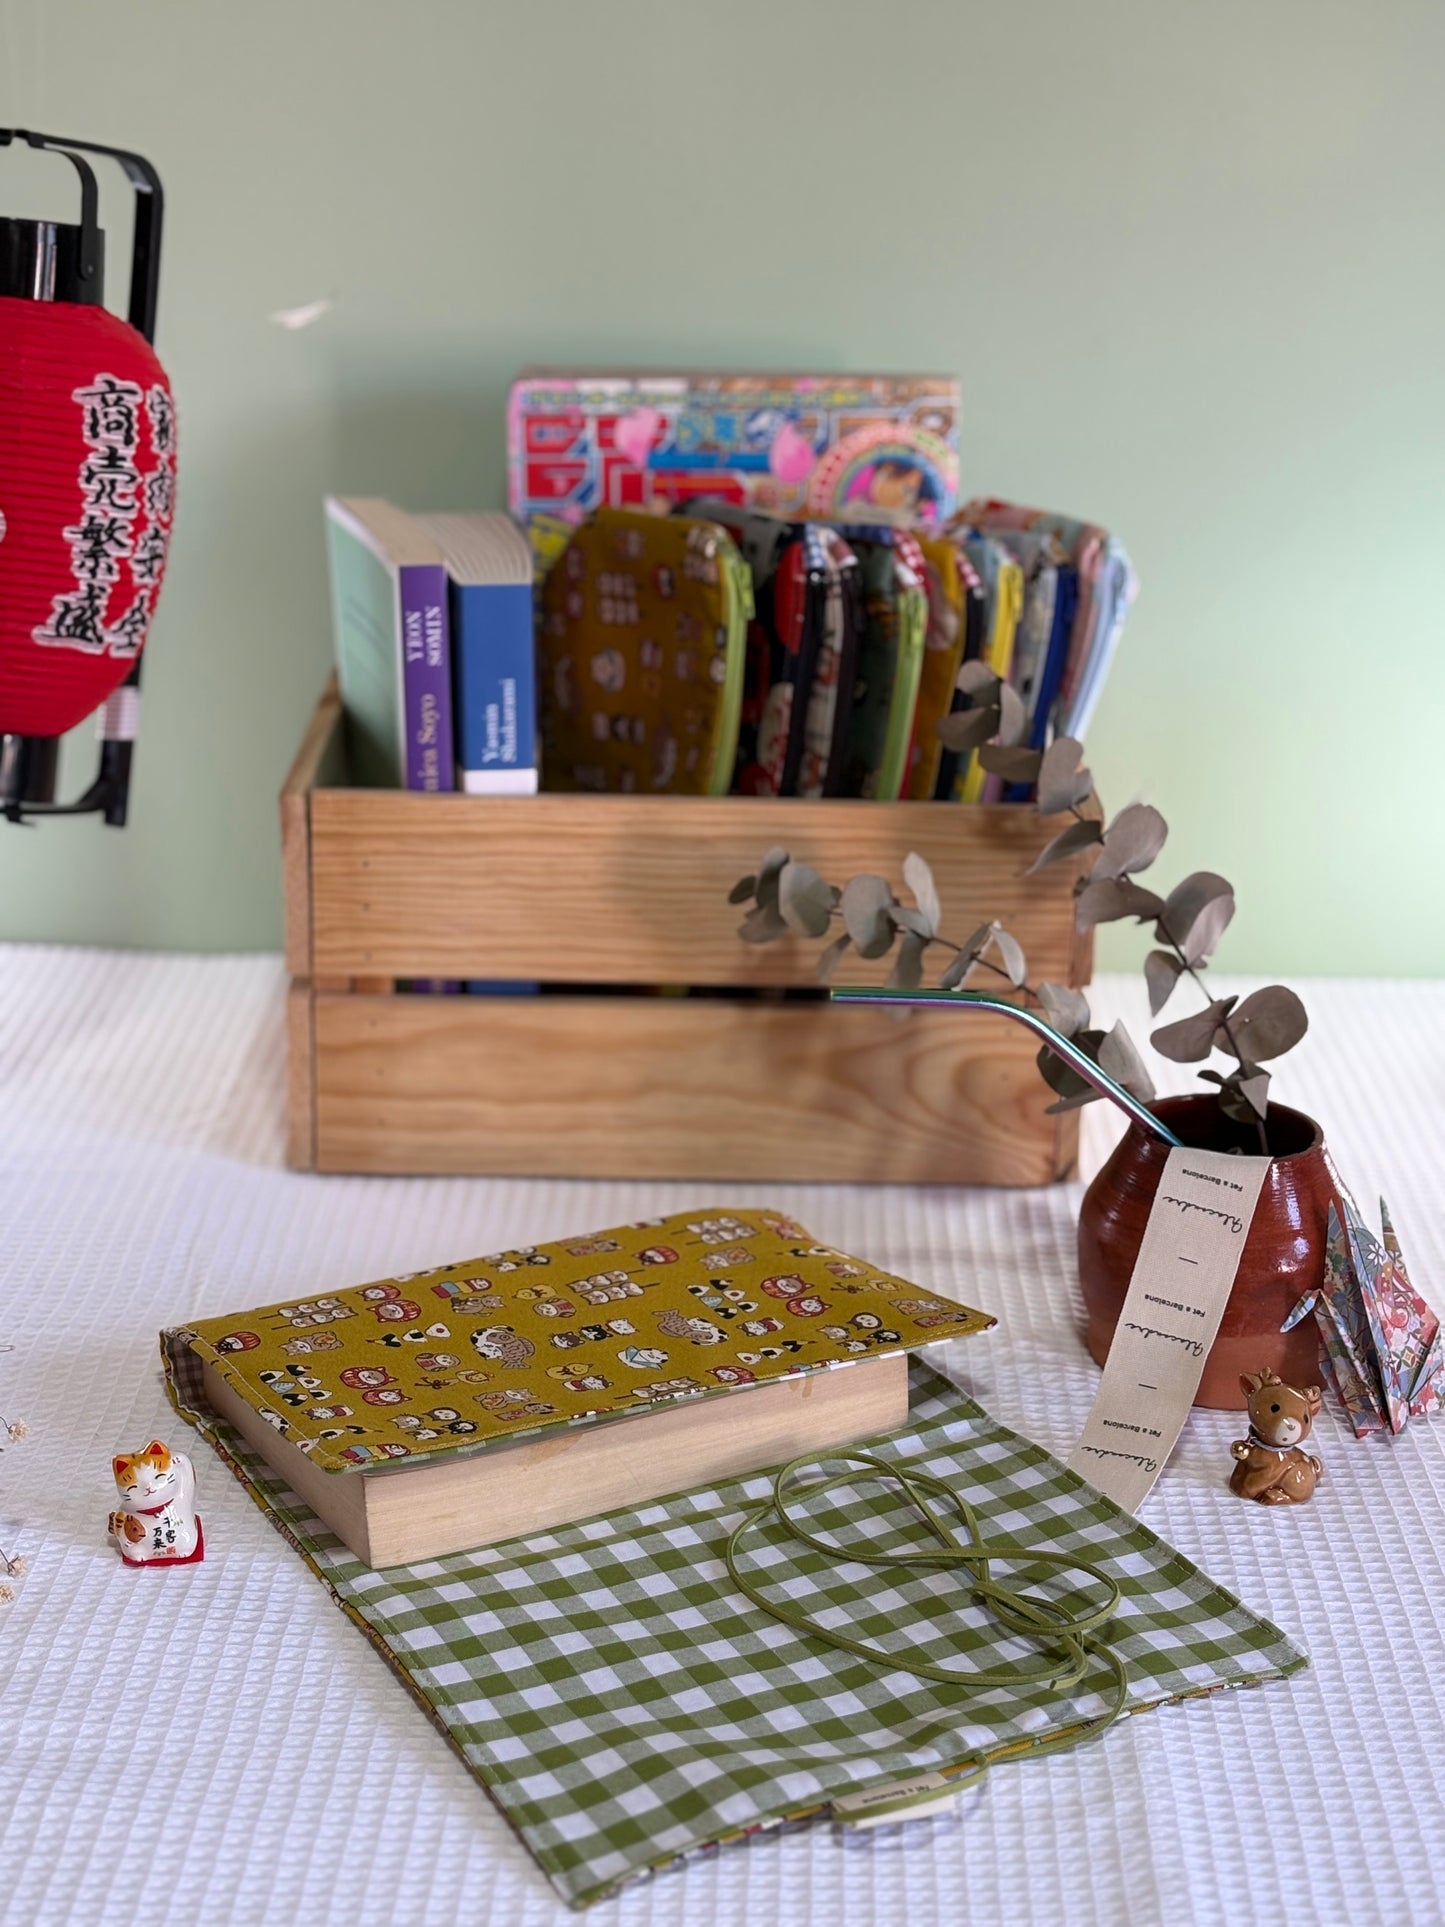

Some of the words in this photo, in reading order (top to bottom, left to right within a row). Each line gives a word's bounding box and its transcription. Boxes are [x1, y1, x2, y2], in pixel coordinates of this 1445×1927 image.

[406, 610, 423, 662] YEON
[424, 605, 443, 668] SOMIN
[416, 693, 440, 744] Soyo
[1181, 1168, 1222, 1187] Barcelona
[1229, 1182, 1244, 1193] Fet
[1144, 1293, 1184, 1312] Barcelona
[1191, 1307, 1206, 1318] Fet
[1102, 1419, 1140, 1434] Barcelona
[1148, 1428, 1162, 1438] Fet
[152, 1526, 167, 1550] 万来
